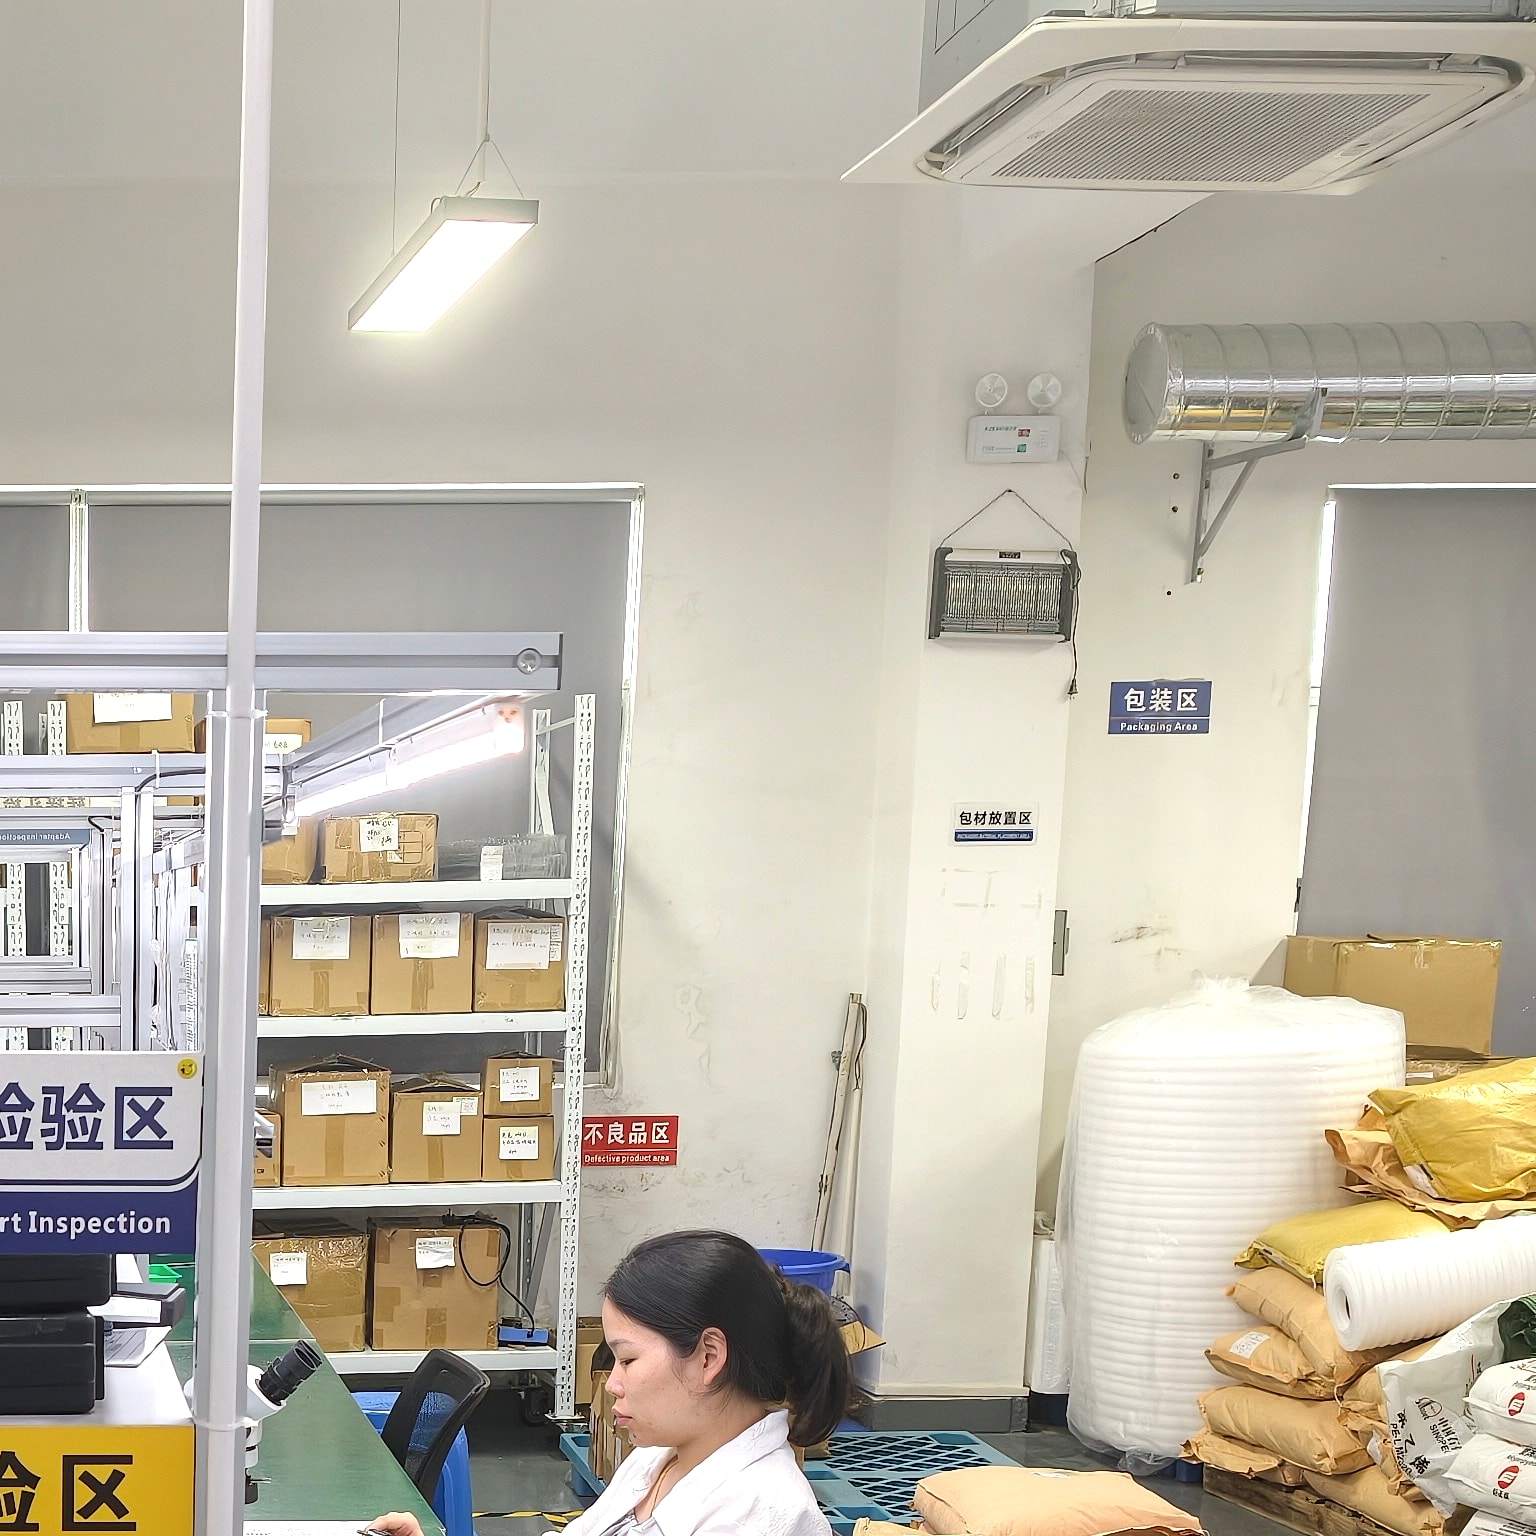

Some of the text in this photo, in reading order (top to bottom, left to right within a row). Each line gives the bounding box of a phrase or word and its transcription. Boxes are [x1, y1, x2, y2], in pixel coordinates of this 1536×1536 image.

[1124, 688, 1198, 711] 包装区
[1120, 722, 1198, 732] Packaging Area
[959, 811, 1032, 825] 包材放置区
[584, 1122, 670, 1145] 不良品区
[584, 1154, 620, 1163] Defective
[621, 1154, 651, 1164] product
[28, 1209, 171, 1238] Inspection
